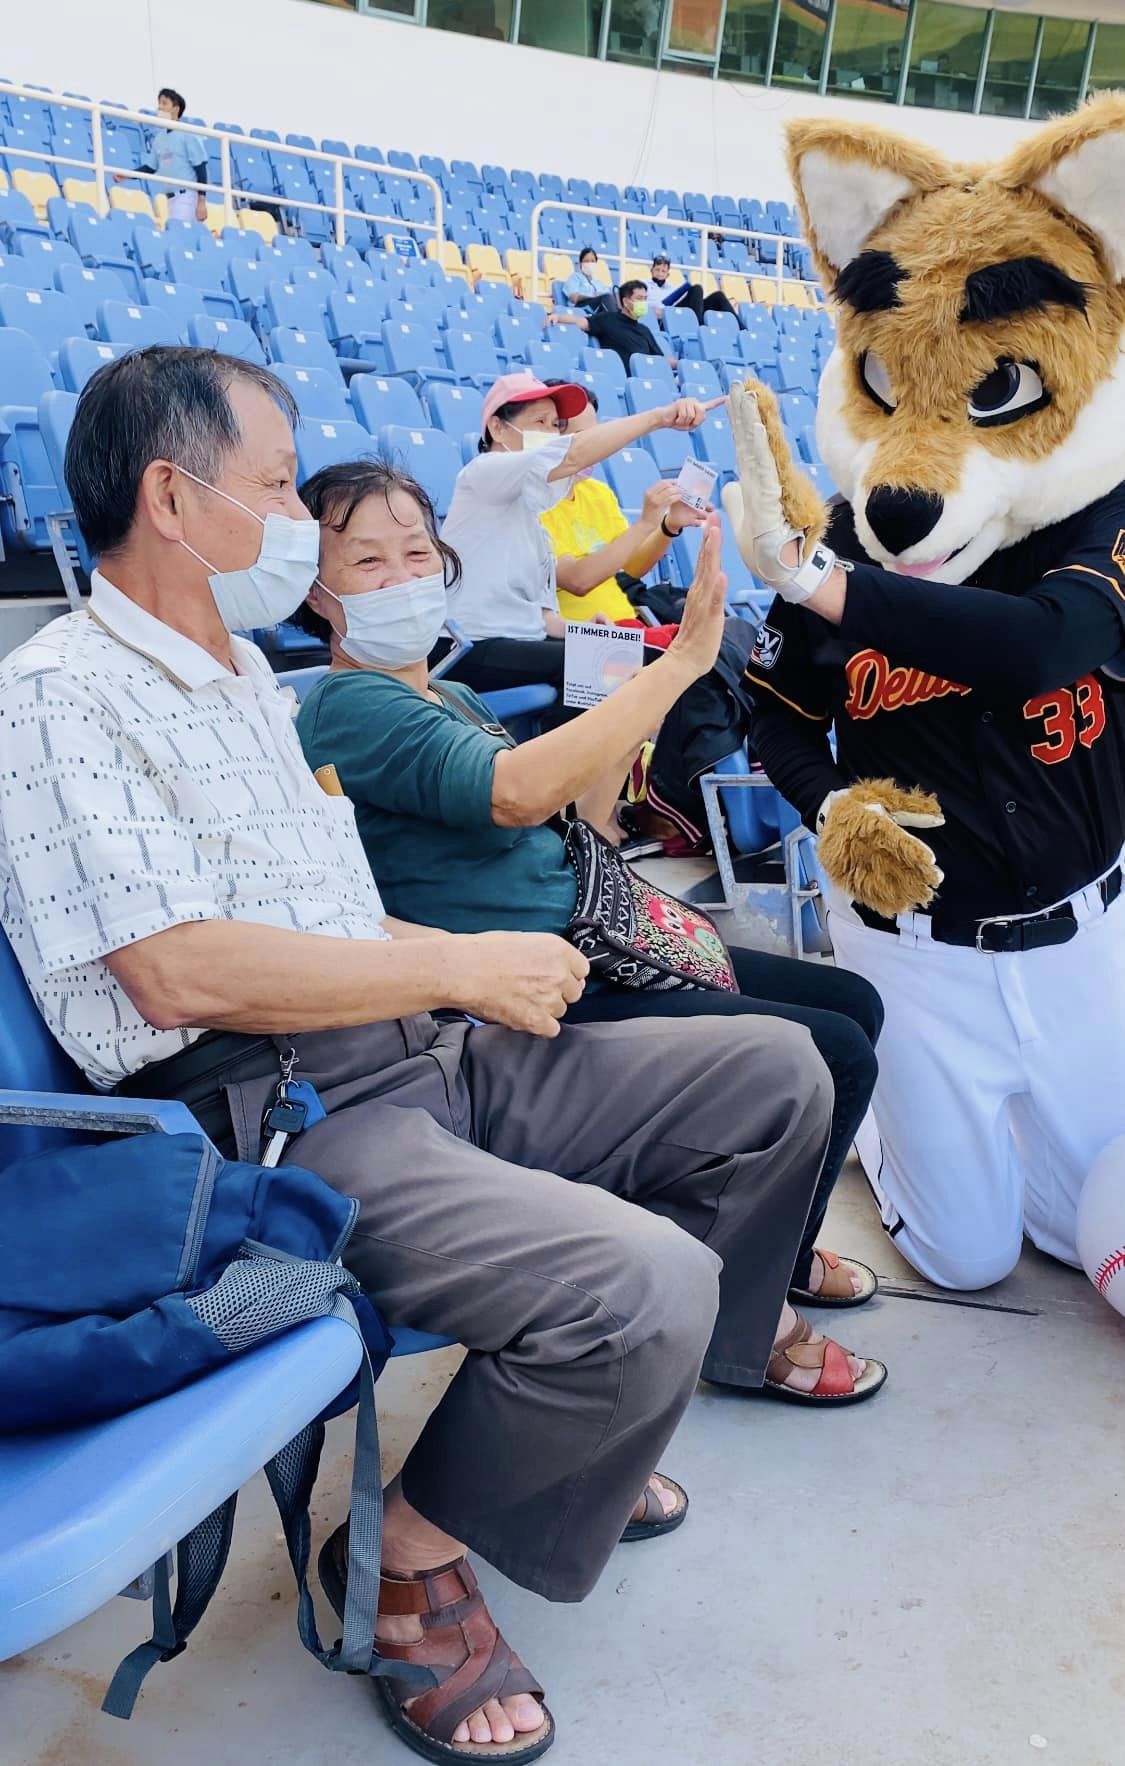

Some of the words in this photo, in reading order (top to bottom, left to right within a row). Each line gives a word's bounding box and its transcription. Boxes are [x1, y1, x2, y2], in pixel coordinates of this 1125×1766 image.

[568, 625, 579, 633] IST
[581, 627, 609, 638] IMMER
[611, 630, 641, 642] DABEI!
[1023, 672, 1106, 765] 33
